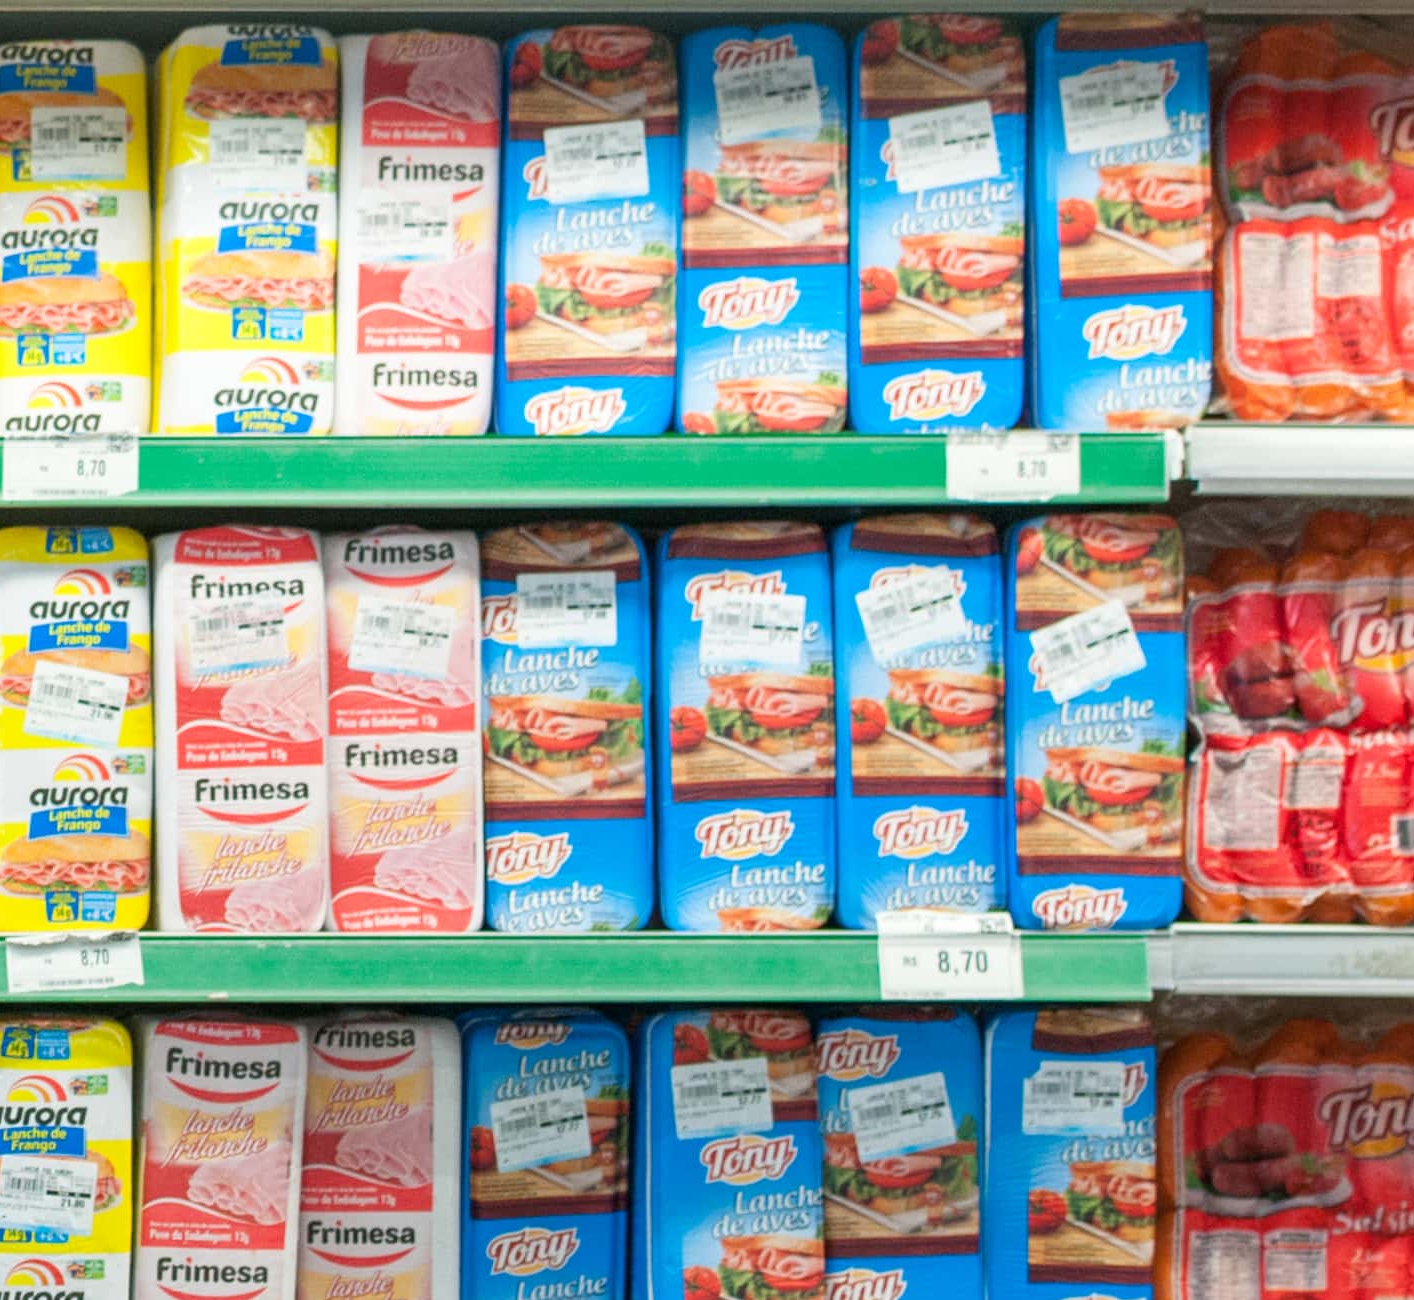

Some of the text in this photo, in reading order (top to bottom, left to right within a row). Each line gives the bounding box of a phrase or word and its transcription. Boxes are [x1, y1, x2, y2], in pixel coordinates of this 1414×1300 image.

[377, 158, 484, 182] Frimesa
[556, 201, 656, 230] Lanche
[891, 208, 993, 235] de aves
[701, 280, 798, 326] Tony
[732, 328, 830, 356] Lanche
[1085, 308, 1184, 357] Tony
[373, 364, 479, 388] Frimesa
[886, 372, 984, 419] Tony
[194, 778, 309, 803] Frimesa
[696, 810, 794, 857] Tony
[874, 807, 969, 854] Tony
[486, 833, 571, 879] Tony
[731, 861, 826, 887] Lanche
[1034, 887, 1126, 926] Tony
[79, 949, 109, 967] 8,70
[937, 950, 988, 975] 8,70
[166, 1049, 282, 1080] Frimesa
[735, 1186, 823, 1214] Lanche
[307, 1221, 416, 1247] Frimesa
[157, 1256, 269, 1285] Frimesa
